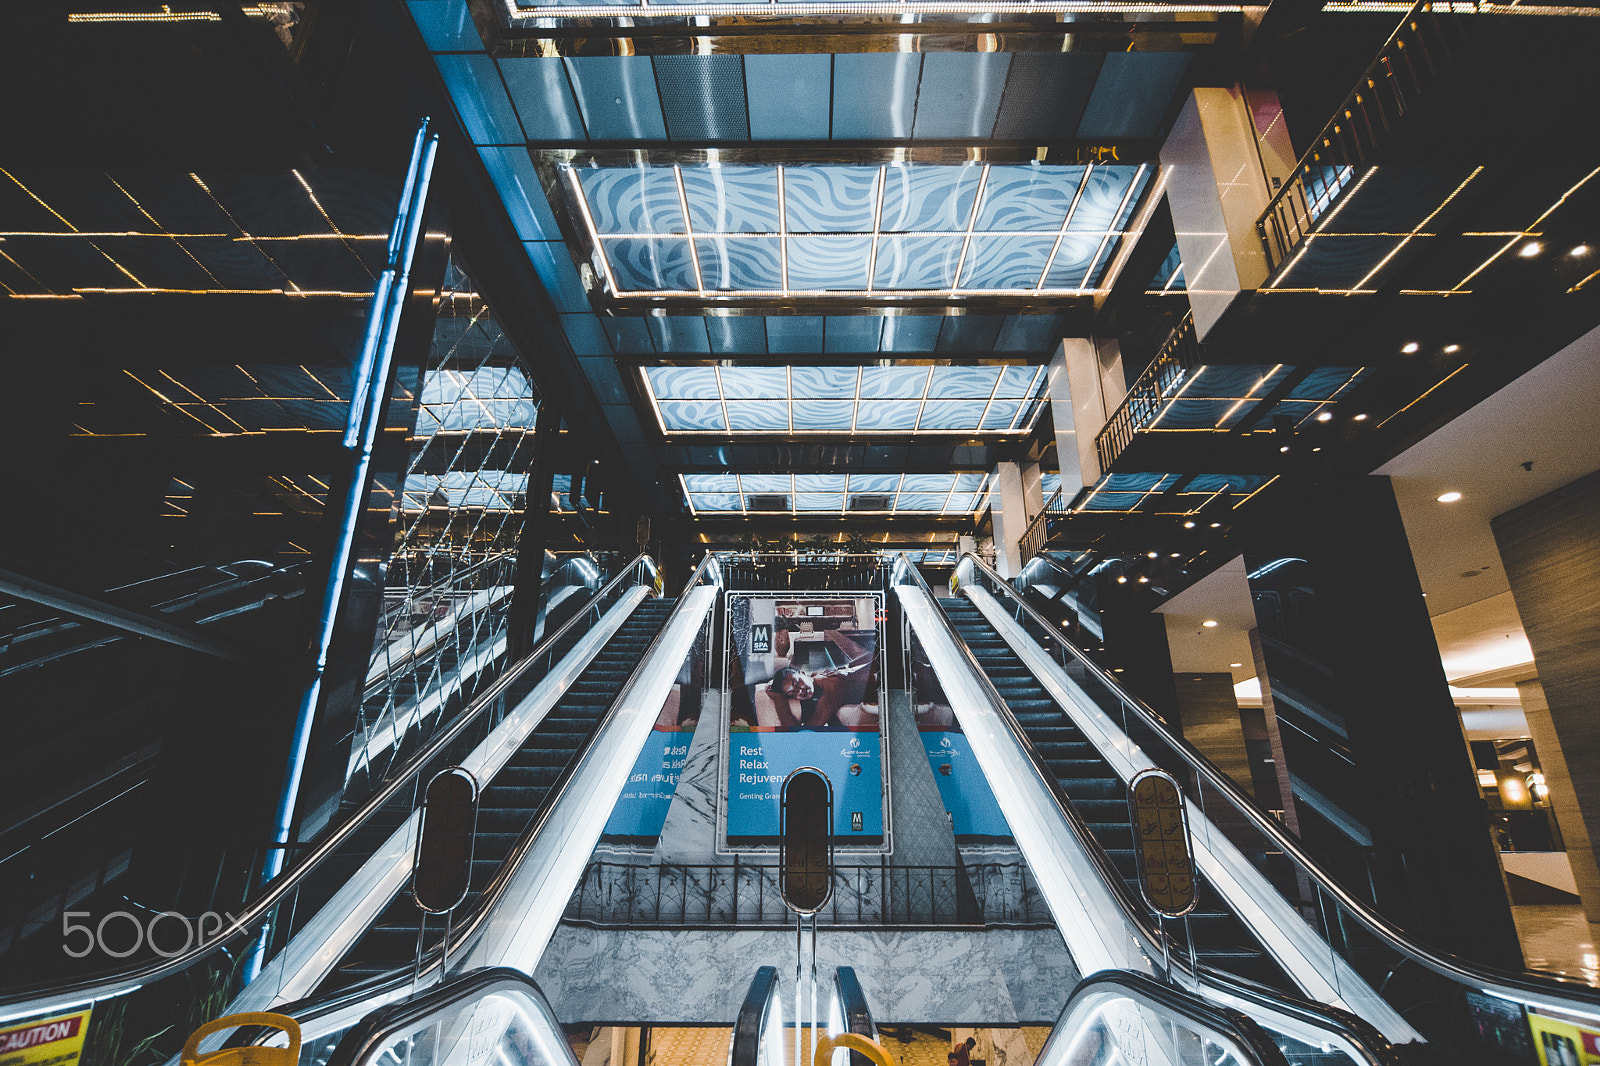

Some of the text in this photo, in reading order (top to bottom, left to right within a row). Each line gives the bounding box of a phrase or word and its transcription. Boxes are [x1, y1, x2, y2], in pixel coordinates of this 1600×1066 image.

[754, 627, 769, 641] M
[740, 746, 763, 756] Rest
[740, 759, 769, 769] Relax
[739, 792, 763, 801] Genting
[853, 813, 862, 823] M
[0, 1021, 72, 1052] CAUTION
